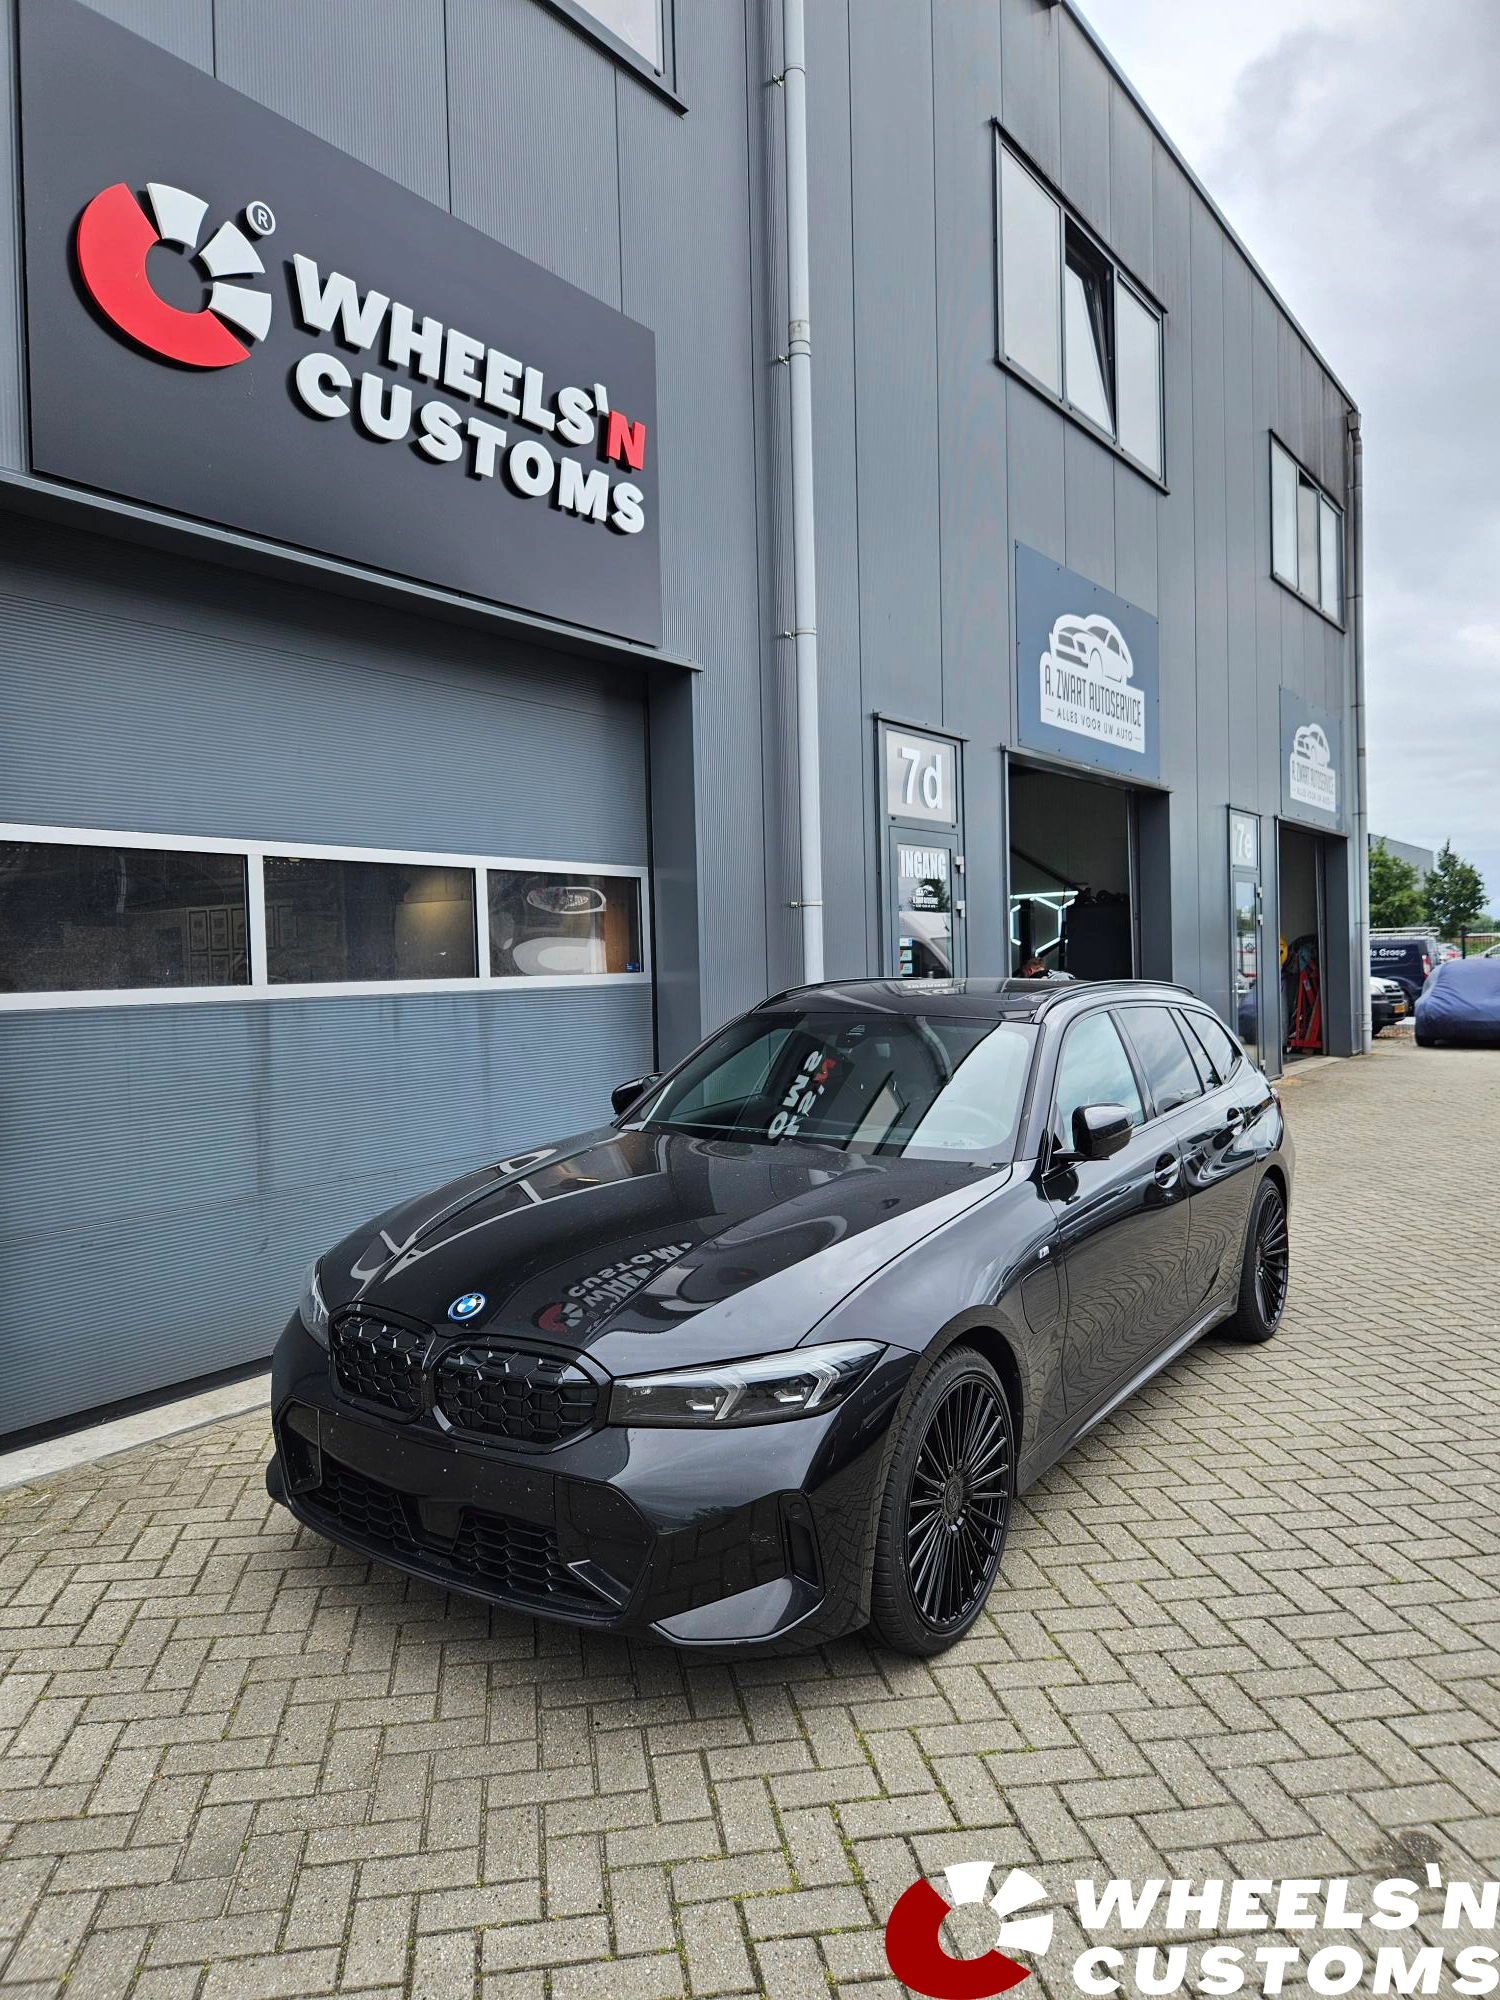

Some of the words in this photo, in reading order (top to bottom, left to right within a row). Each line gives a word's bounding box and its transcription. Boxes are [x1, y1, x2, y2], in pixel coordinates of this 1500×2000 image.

[296, 352, 645, 534] CUSTOMS
[1045, 664, 1054, 698] A.
[1056, 668, 1087, 708] ZWART
[1089, 681, 1141, 728] AUTOSERVICE
[1057, 707, 1078, 725] ALLES
[1081, 714, 1101, 732] VOOR
[1103, 722, 1114, 735] UW
[1116, 728, 1133, 742] AUTO
[901, 746, 943, 809] 7d
[900, 849, 946, 880] INGANG
[1236, 823, 1252, 858] 7e
